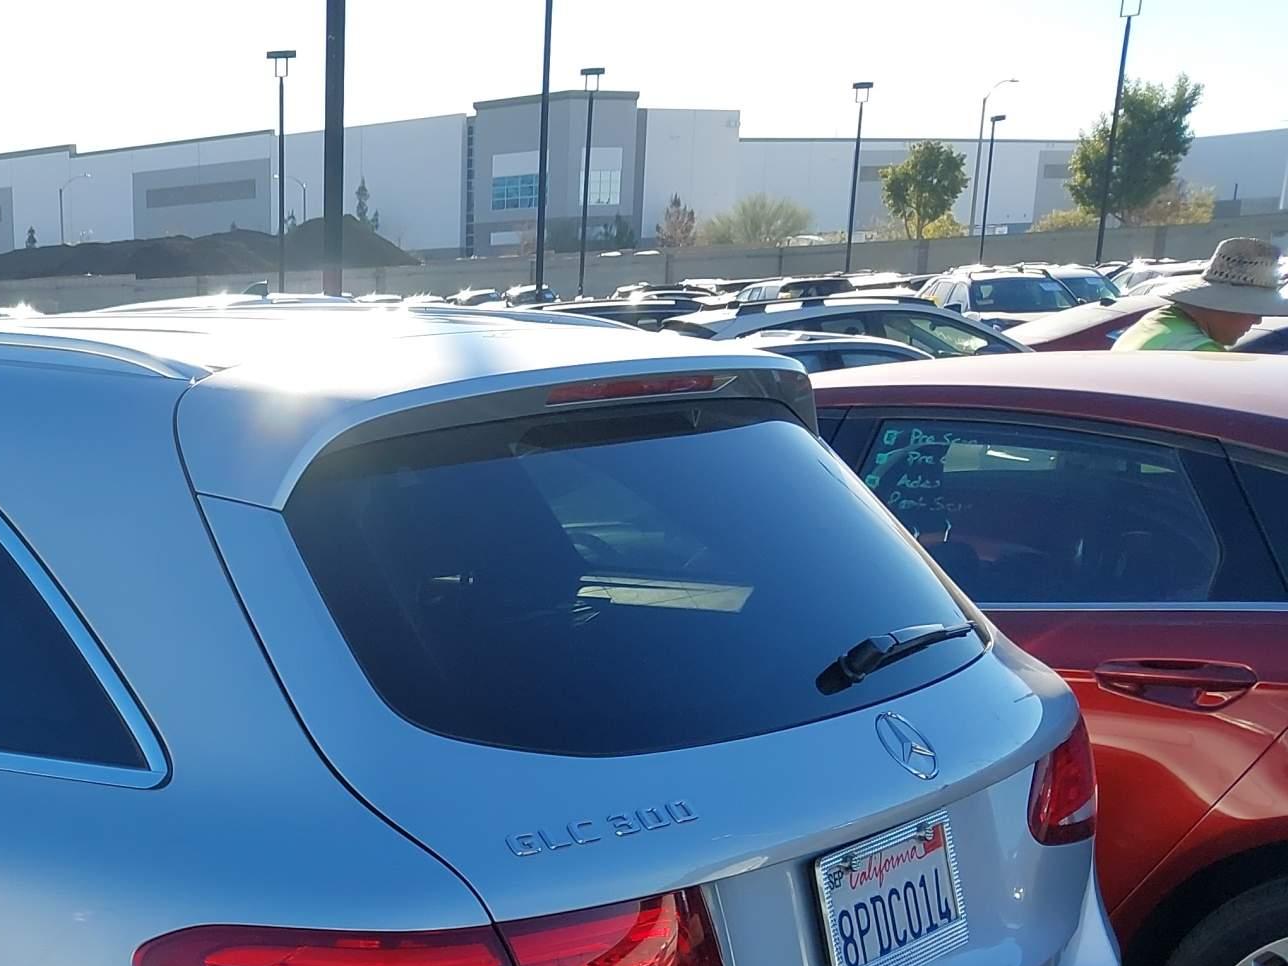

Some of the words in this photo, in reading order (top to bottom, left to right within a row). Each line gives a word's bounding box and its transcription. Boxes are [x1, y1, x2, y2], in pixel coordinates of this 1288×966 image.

[911, 428, 935, 447] Pre
[505, 819, 601, 857] GLC
[606, 799, 699, 837] 300
[827, 869, 844, 891] SEP
[849, 843, 926, 890] California
